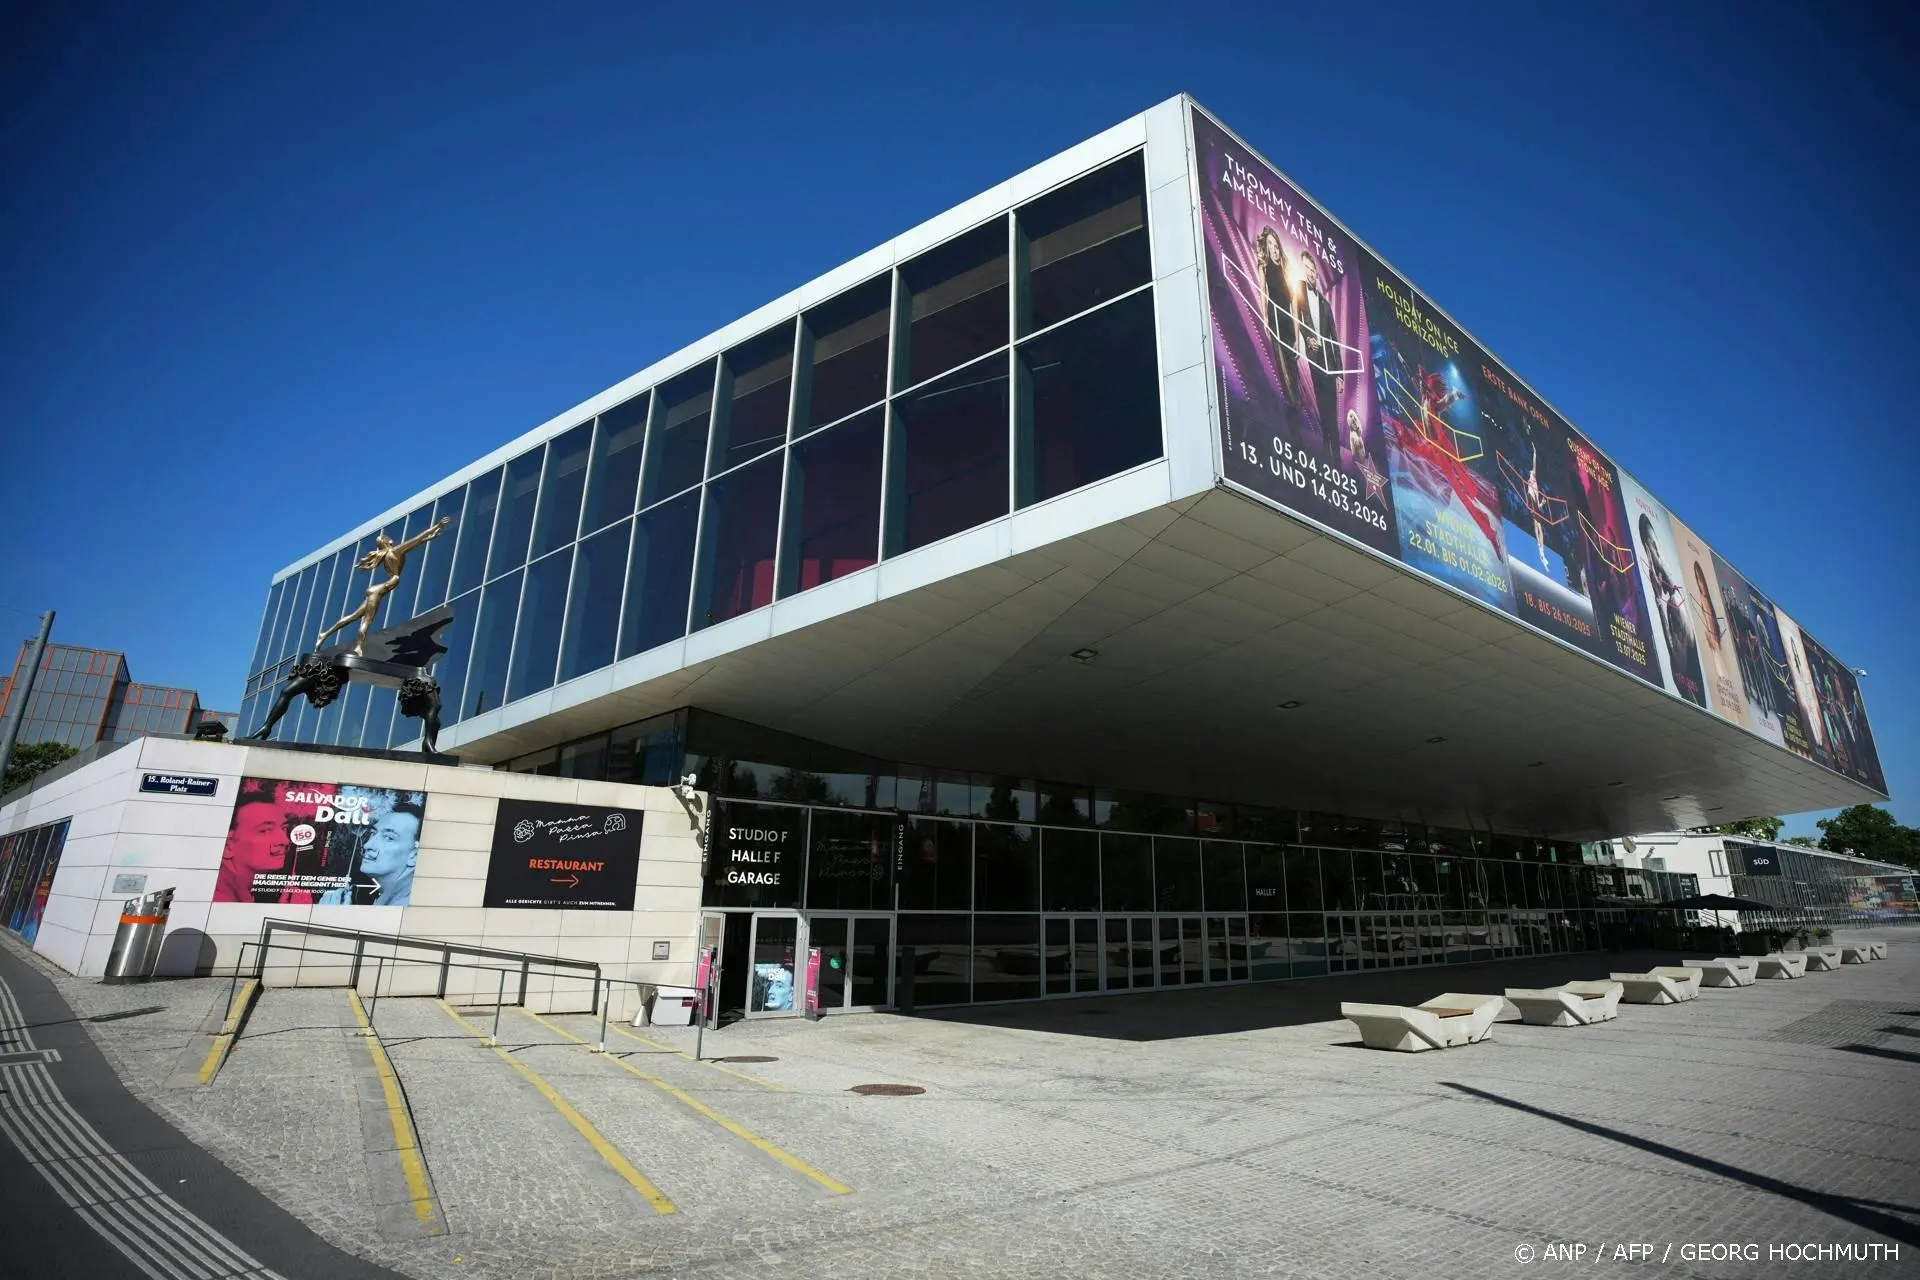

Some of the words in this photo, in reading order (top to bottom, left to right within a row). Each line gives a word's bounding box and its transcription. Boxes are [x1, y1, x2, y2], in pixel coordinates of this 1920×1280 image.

[1224, 152, 1292, 217] THOMMY
[1297, 211, 1322, 243] TEN
[1327, 237, 1336, 254] &
[1222, 170, 1276, 222] AMÉLIE
[1281, 215, 1308, 247] VAN
[1313, 240, 1344, 274] TASS
[1376, 278, 1422, 324] HOLIDAY
[1426, 318, 1440, 338] ON
[1444, 332, 1459, 354] ICE
[1396, 309, 1448, 358] HORIZONS
[1481, 365, 1506, 393] ERSTE
[1508, 386, 1528, 412] BANK
[1530, 406, 1549, 430] OPEN
[1273, 436, 1358, 496] 05.04.2025
[1240, 442, 1264, 468] 13.
[1270, 456, 1306, 488] UND
[1312, 479, 1386, 531] 14.03.2026
[1426, 520, 1488, 567] STADTHALLE
[1408, 529, 1440, 558] 22.01.
[1442, 547, 1458, 568] BIS
[1460, 556, 1508, 593] 01.02.2026
[1524, 592, 1537, 608] 18.
[1538, 599, 1551, 616] BIS
[1552, 606, 1591, 636] 26.10.2025
[1614, 612, 1636, 636] WIENER
[1610, 624, 1646, 652] STADTHALLE
[160, 776, 213, 786] Roland-Rainer-
[170, 784, 188, 792] Platz
[284, 791, 369, 806] SALVADOR
[536, 816, 590, 828] Mamma
[294, 831, 312, 840] 150
[560, 832, 602, 843] Pinsa
[703, 810, 711, 862] EINGANG
[729, 828, 778, 842] STUDIO
[781, 831, 788, 843] F
[529, 858, 604, 872] RESTAURANT
[731, 849, 771, 863] HALLE
[774, 852, 781, 863] F
[728, 871, 780, 885] GARAGE
[1256, 887, 1273, 897] HALLE
